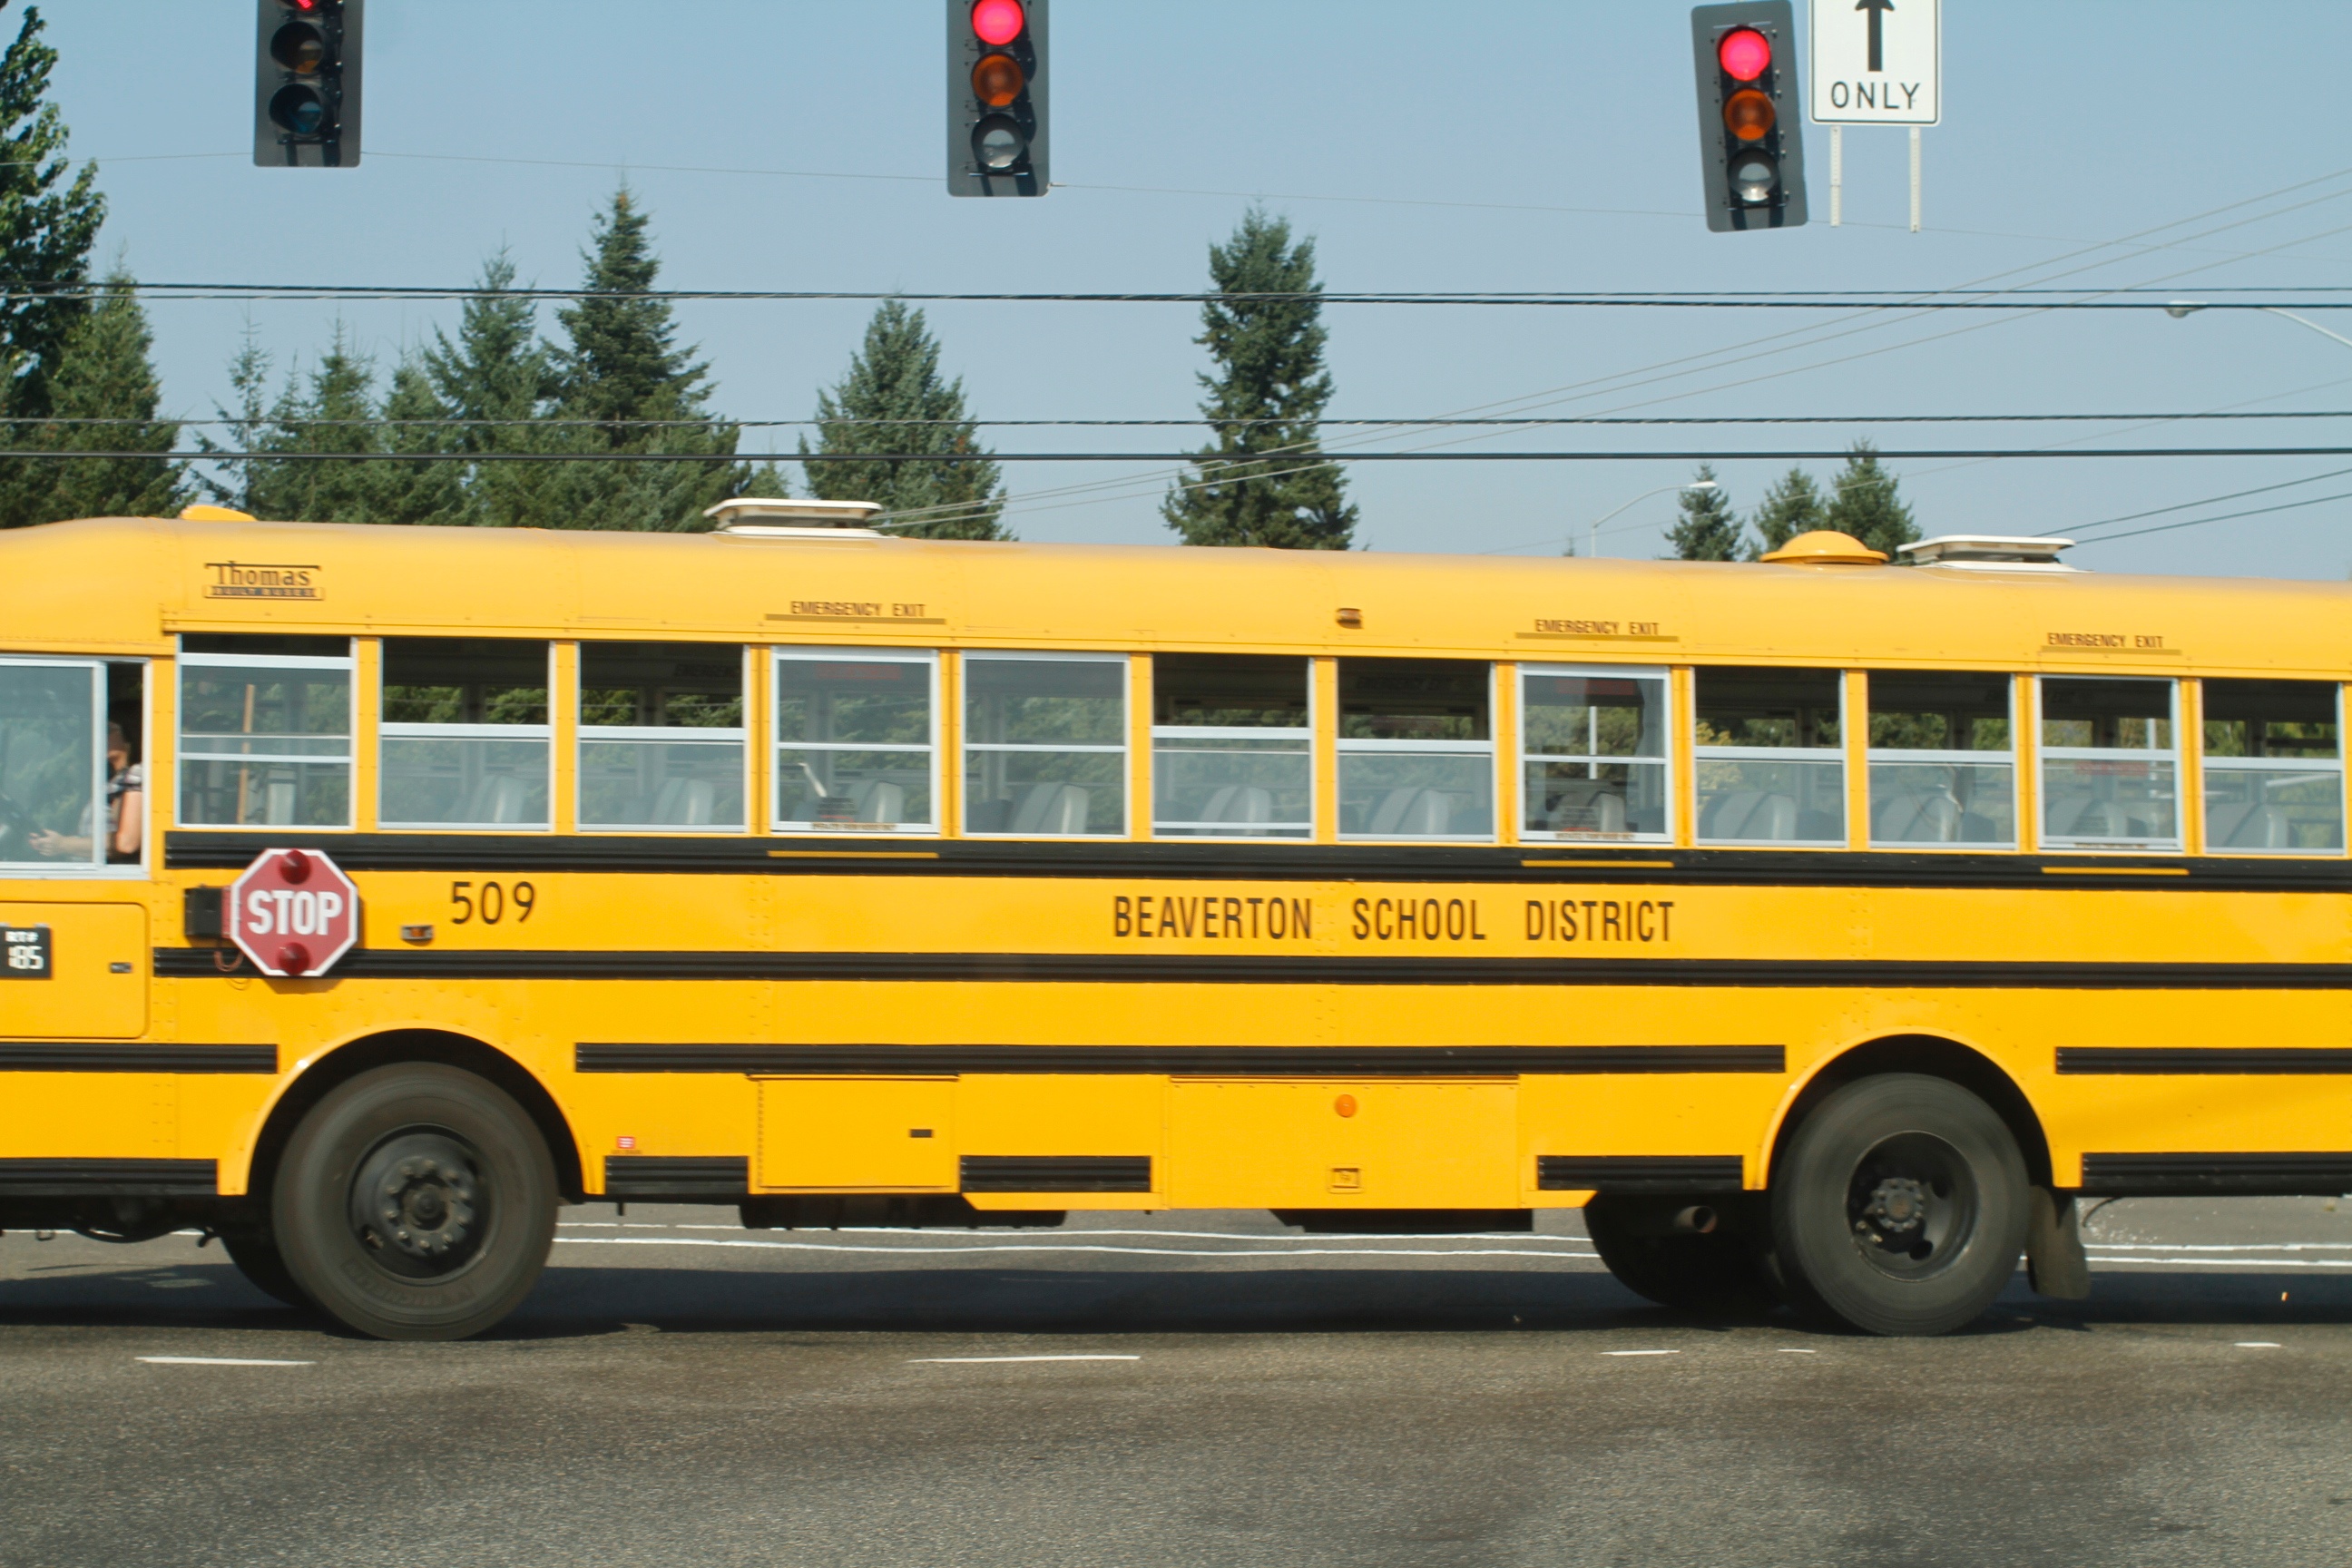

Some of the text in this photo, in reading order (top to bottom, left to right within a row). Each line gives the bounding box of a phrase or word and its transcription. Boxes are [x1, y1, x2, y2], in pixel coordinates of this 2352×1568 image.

[1831, 81, 1920, 110] ONLY
[206, 560, 320, 586] Thomas
[790, 601, 926, 617] EMERGENCY EXIT
[1534, 619, 1659, 635] EMERGENCY EXIT
[2047, 632, 2164, 648] EMERGENCY EXIT
[248, 890, 343, 936] STOP
[450, 881, 535, 925] 509
[1113, 896, 1674, 941] BEAVERTON SCHOOL DISTRICT
